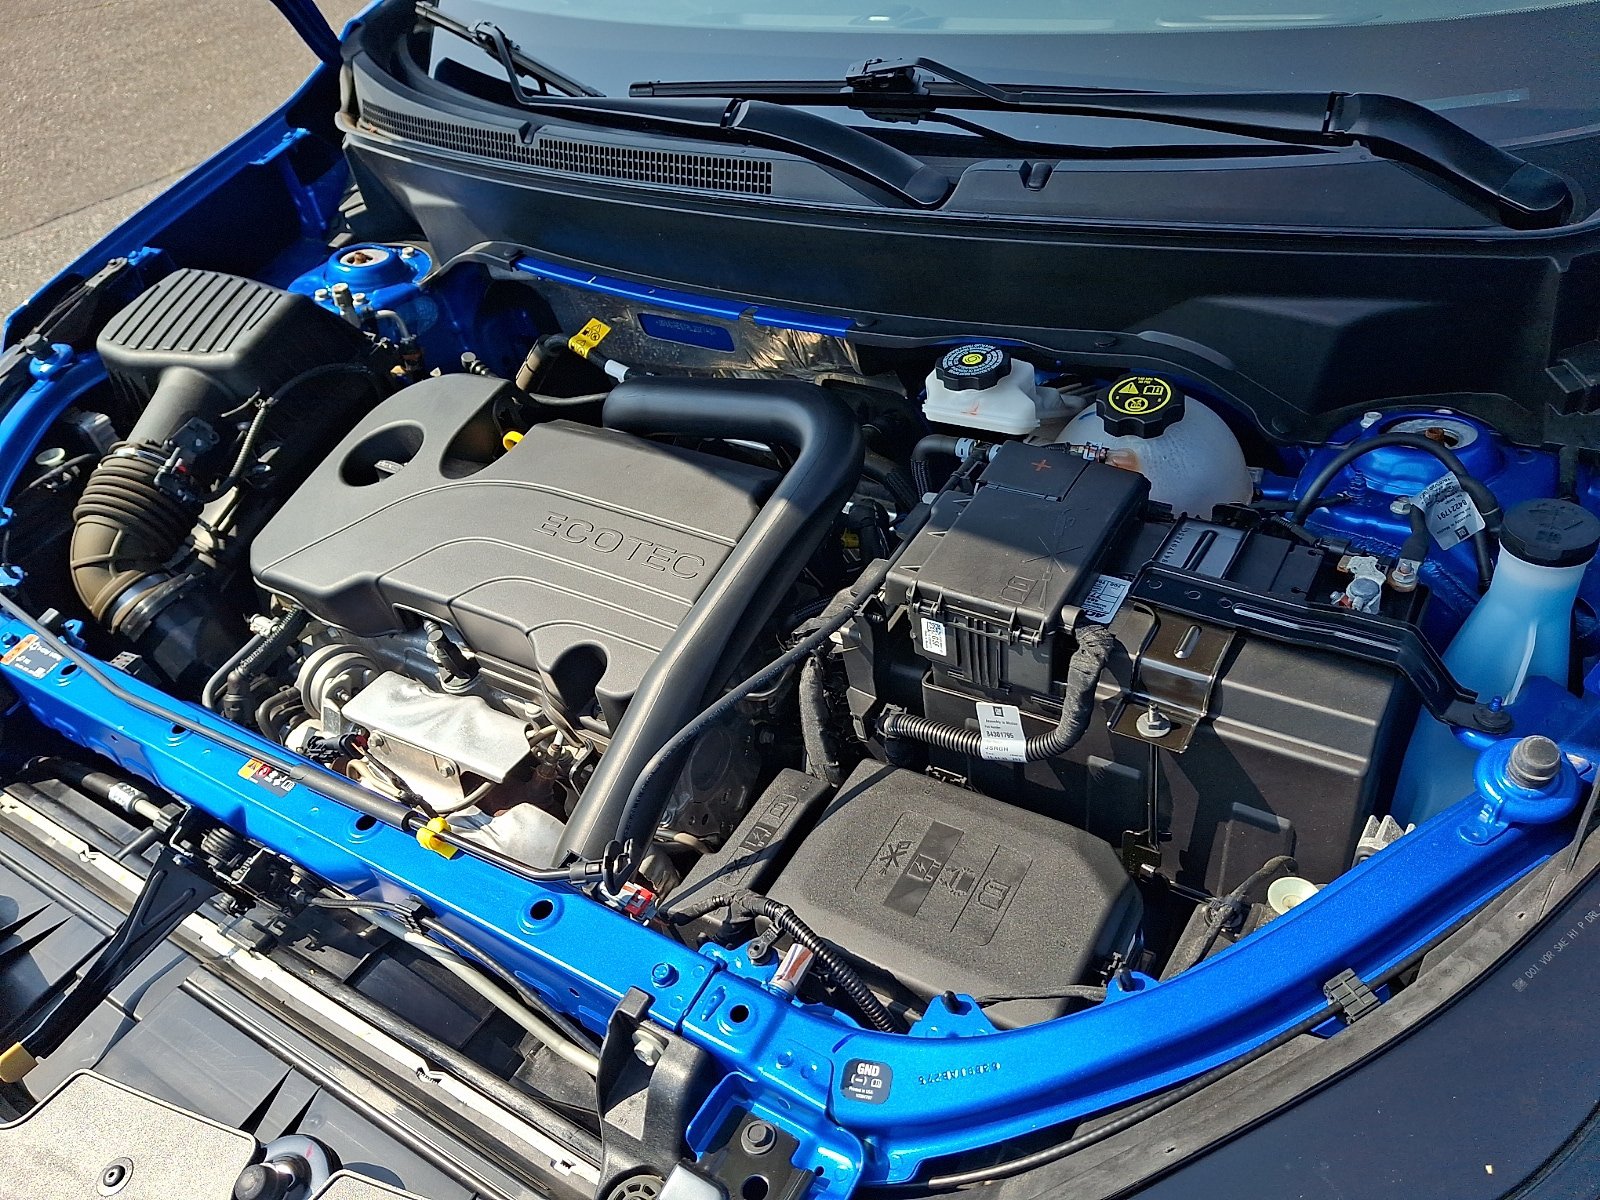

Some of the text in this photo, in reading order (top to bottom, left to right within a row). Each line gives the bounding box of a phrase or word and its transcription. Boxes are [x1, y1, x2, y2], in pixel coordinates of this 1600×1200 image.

[1436, 499, 1468, 521] 84221791
[533, 511, 705, 580] ECOTEC
[1540, 950, 1555, 965] VOR
[1553, 937, 1569, 952] SAE
[1577, 921, 1585, 930] P
[857, 1062, 880, 1077] GND
